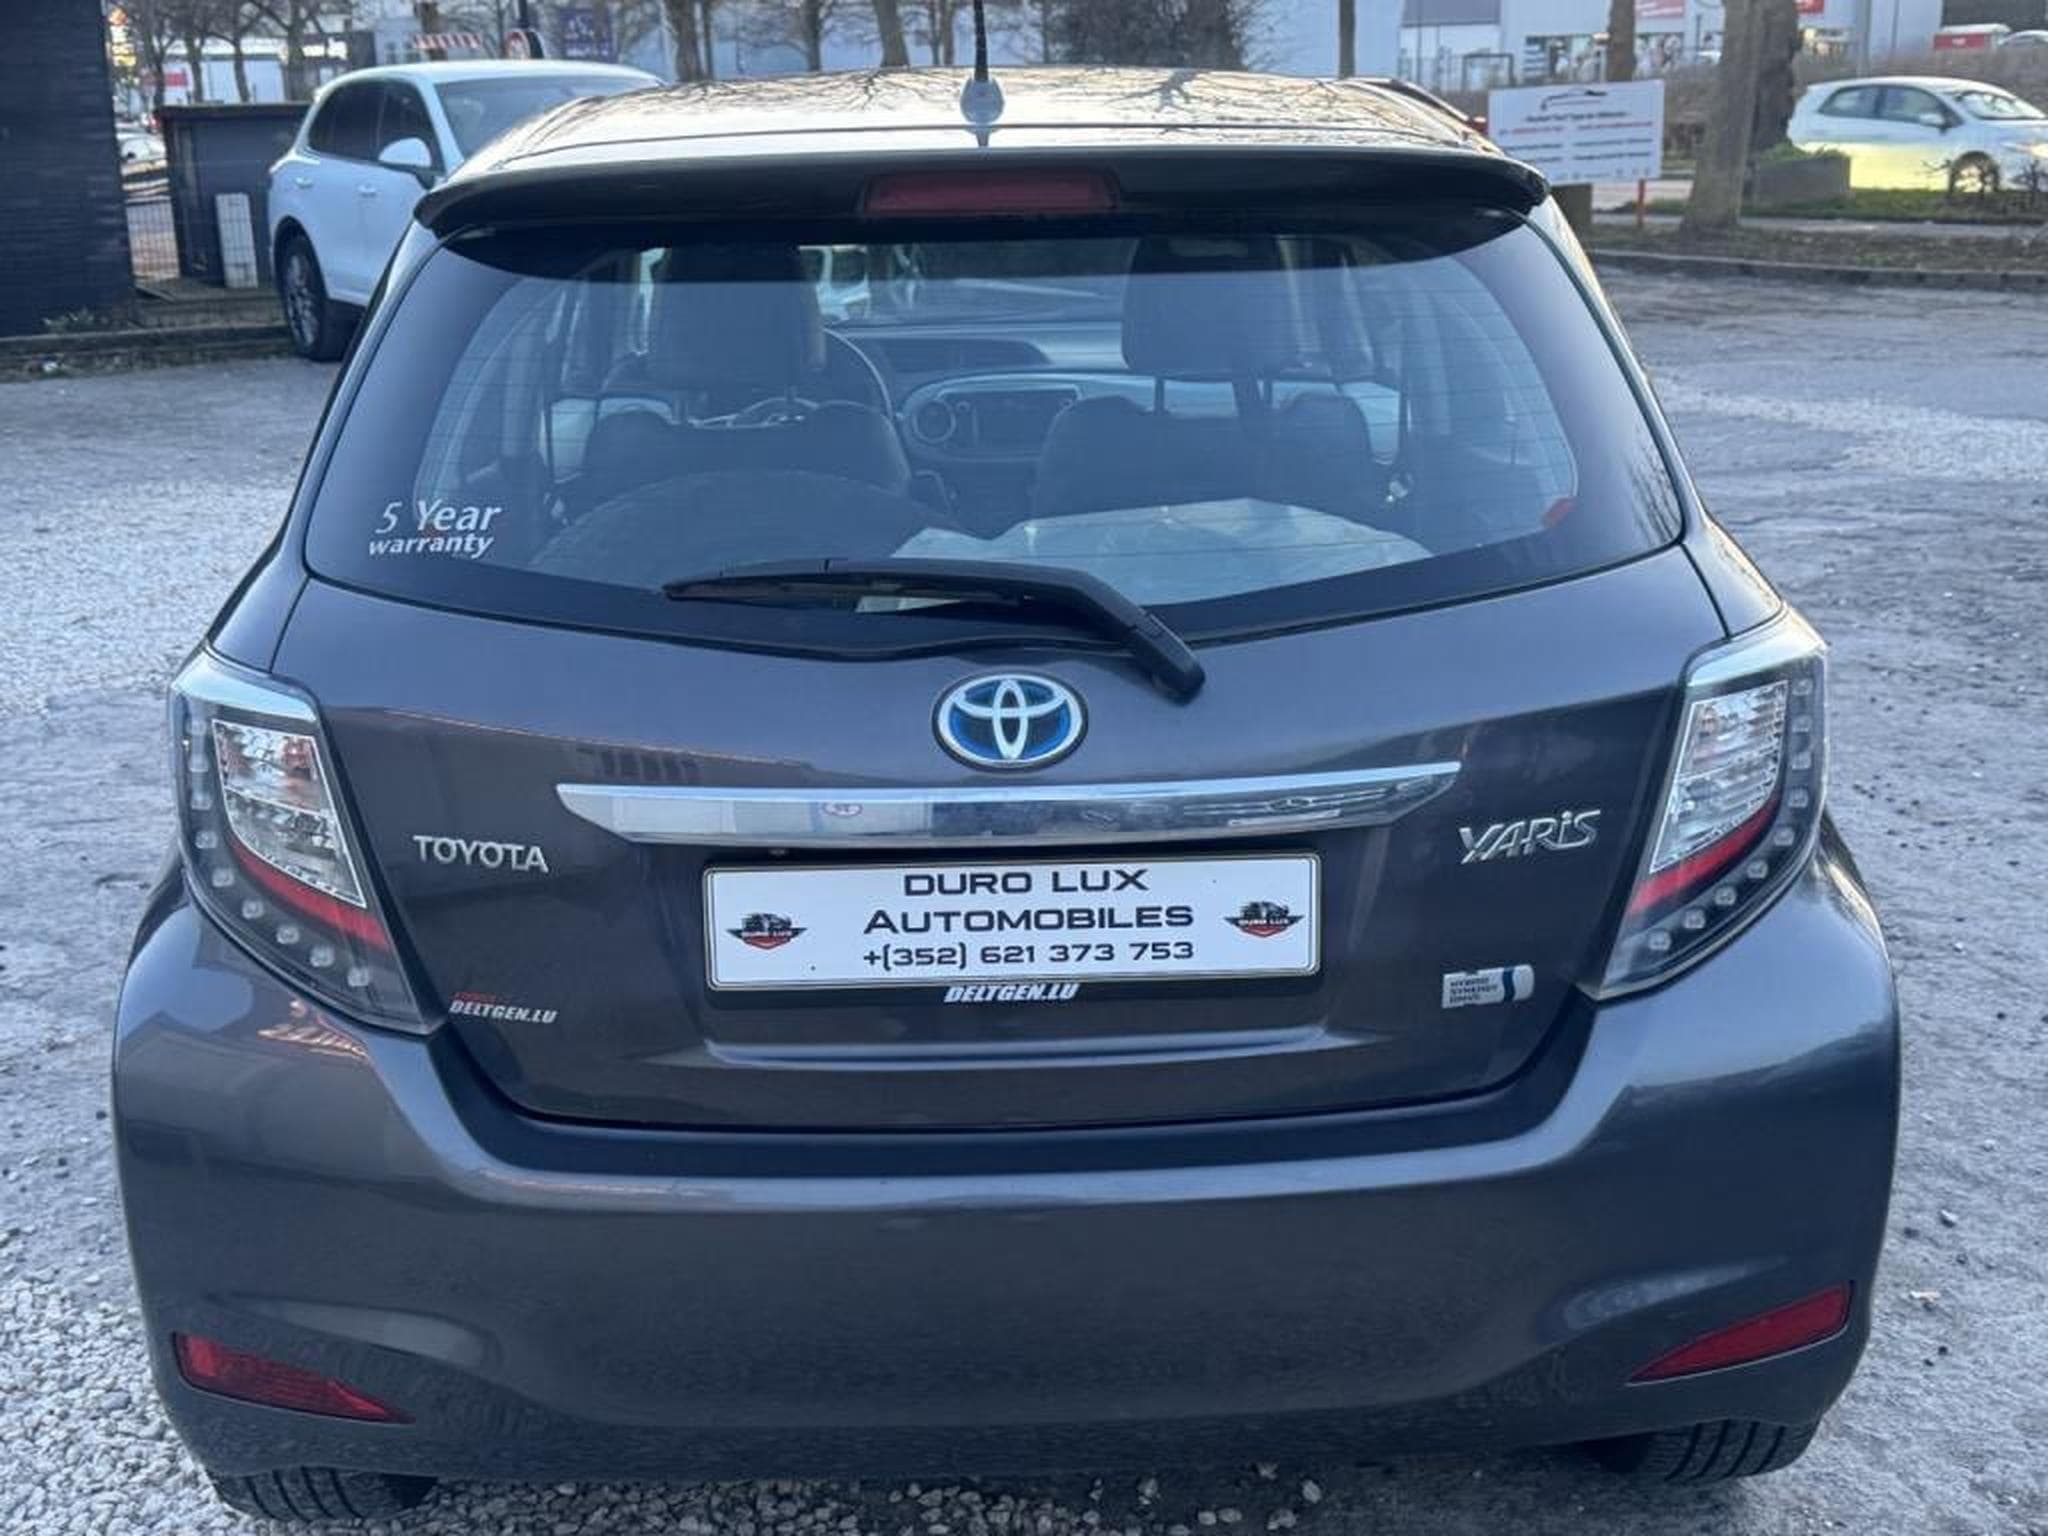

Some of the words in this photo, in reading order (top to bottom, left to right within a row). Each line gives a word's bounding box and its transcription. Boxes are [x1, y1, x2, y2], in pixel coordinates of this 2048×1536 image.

[375, 501, 403, 534] 5
[417, 499, 502, 531] Year
[369, 533, 494, 559] warranty
[412, 835, 549, 873] TOYOTA
[904, 873, 1033, 896] DURO
[1051, 869, 1149, 893] LUX
[863, 941, 967, 971] +(352)
[980, 944, 1036, 964] 621
[1049, 943, 1115, 962] 373
[1128, 942, 1194, 961] 753
[943, 981, 1080, 1004] DELTGEN.LU
